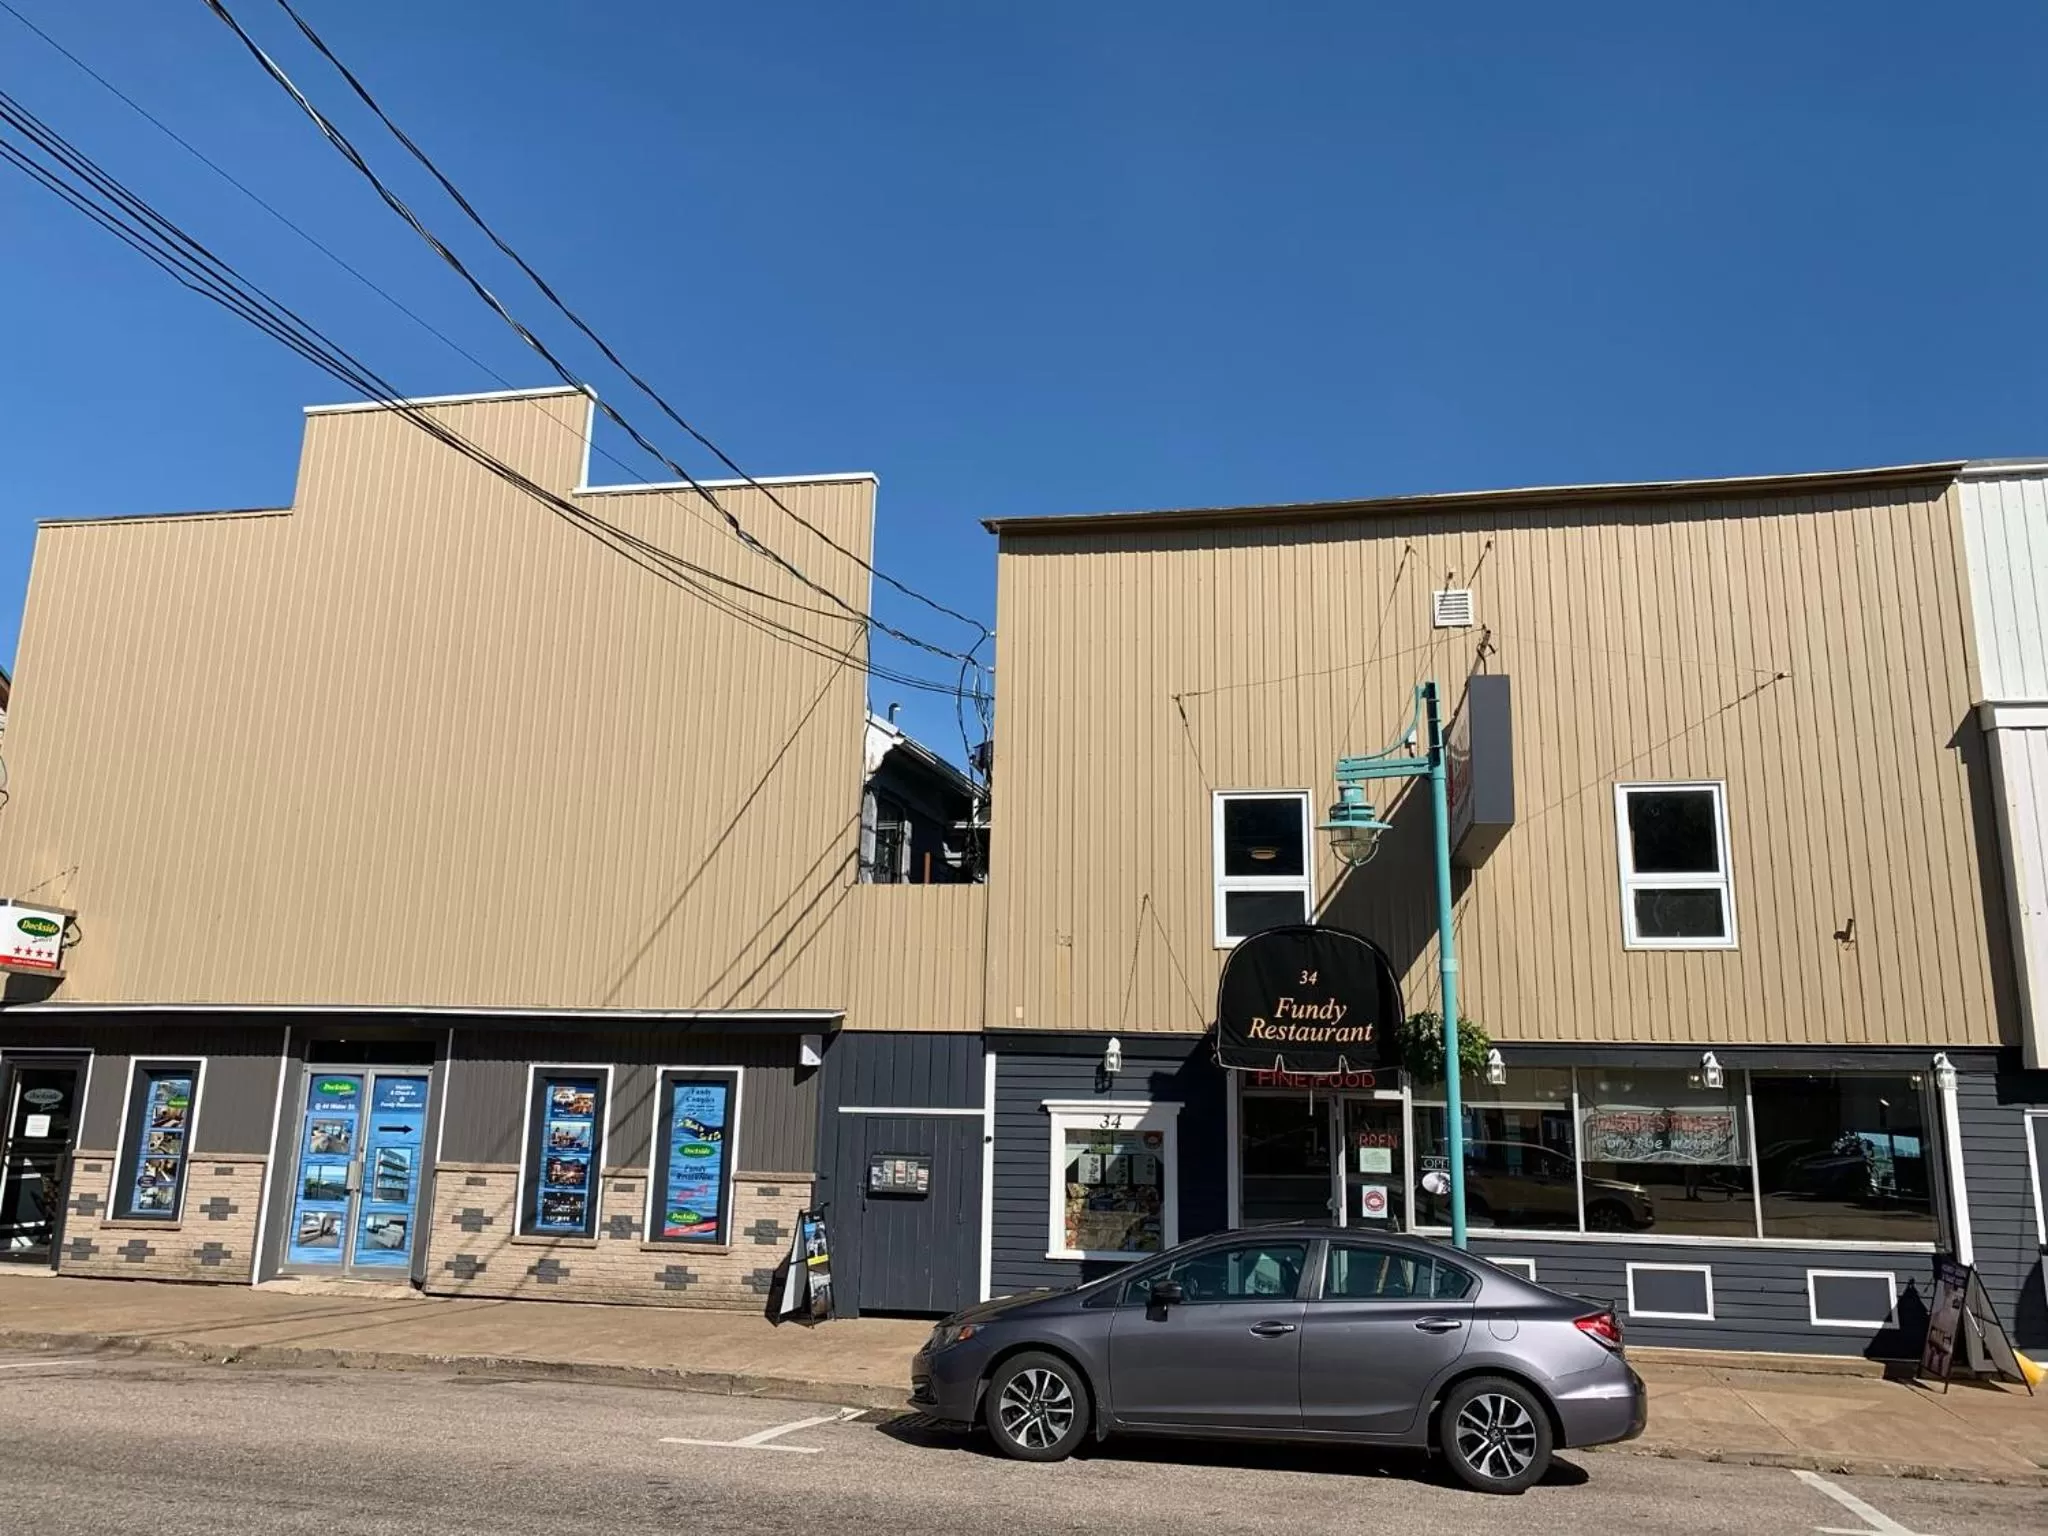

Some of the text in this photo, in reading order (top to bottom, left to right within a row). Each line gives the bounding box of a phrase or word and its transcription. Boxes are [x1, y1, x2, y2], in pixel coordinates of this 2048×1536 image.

[21, 919, 58, 933] Dockside
[1299, 970, 1318, 985] 34
[1274, 997, 1347, 1025] Fundy
[1248, 1017, 1374, 1042] Restaurant
[1257, 1071, 1377, 1088] FINE FOOD
[1099, 1114, 1122, 1128] 34
[1424, 1159, 1450, 1168] OPE
